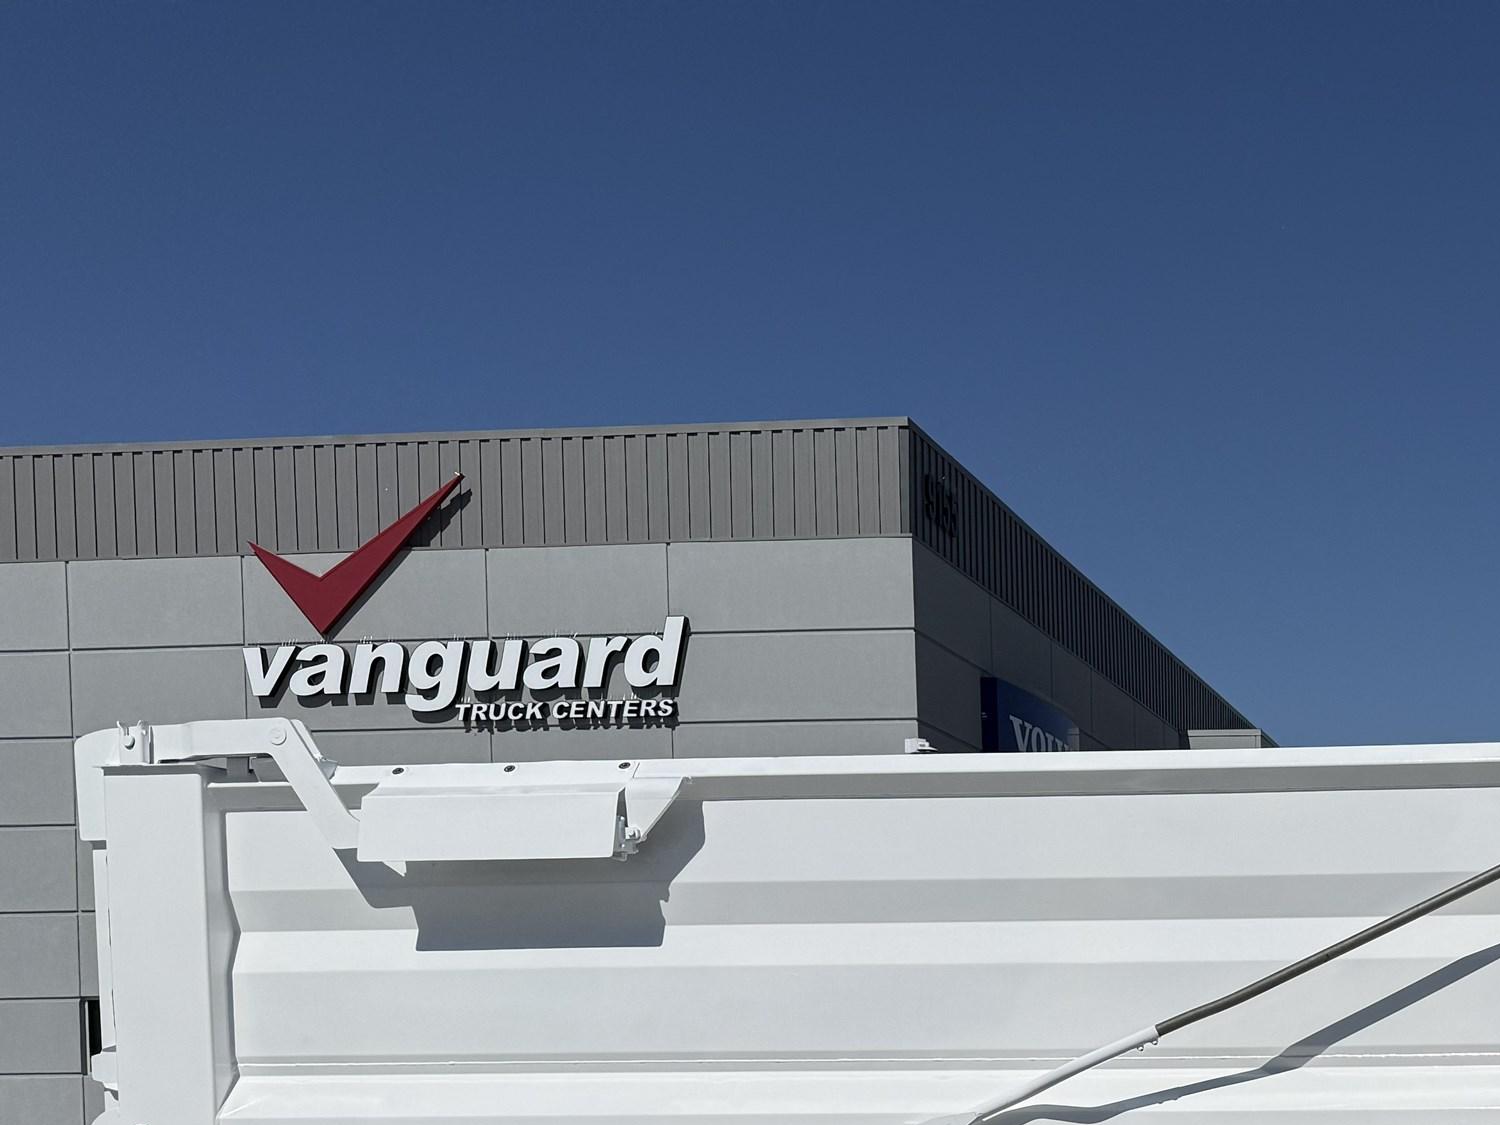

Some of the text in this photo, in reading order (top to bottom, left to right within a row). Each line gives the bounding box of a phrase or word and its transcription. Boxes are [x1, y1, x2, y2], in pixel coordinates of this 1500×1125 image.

[242, 615, 687, 712] vanguard
[455, 698, 675, 721] TRUCK CENTERS
